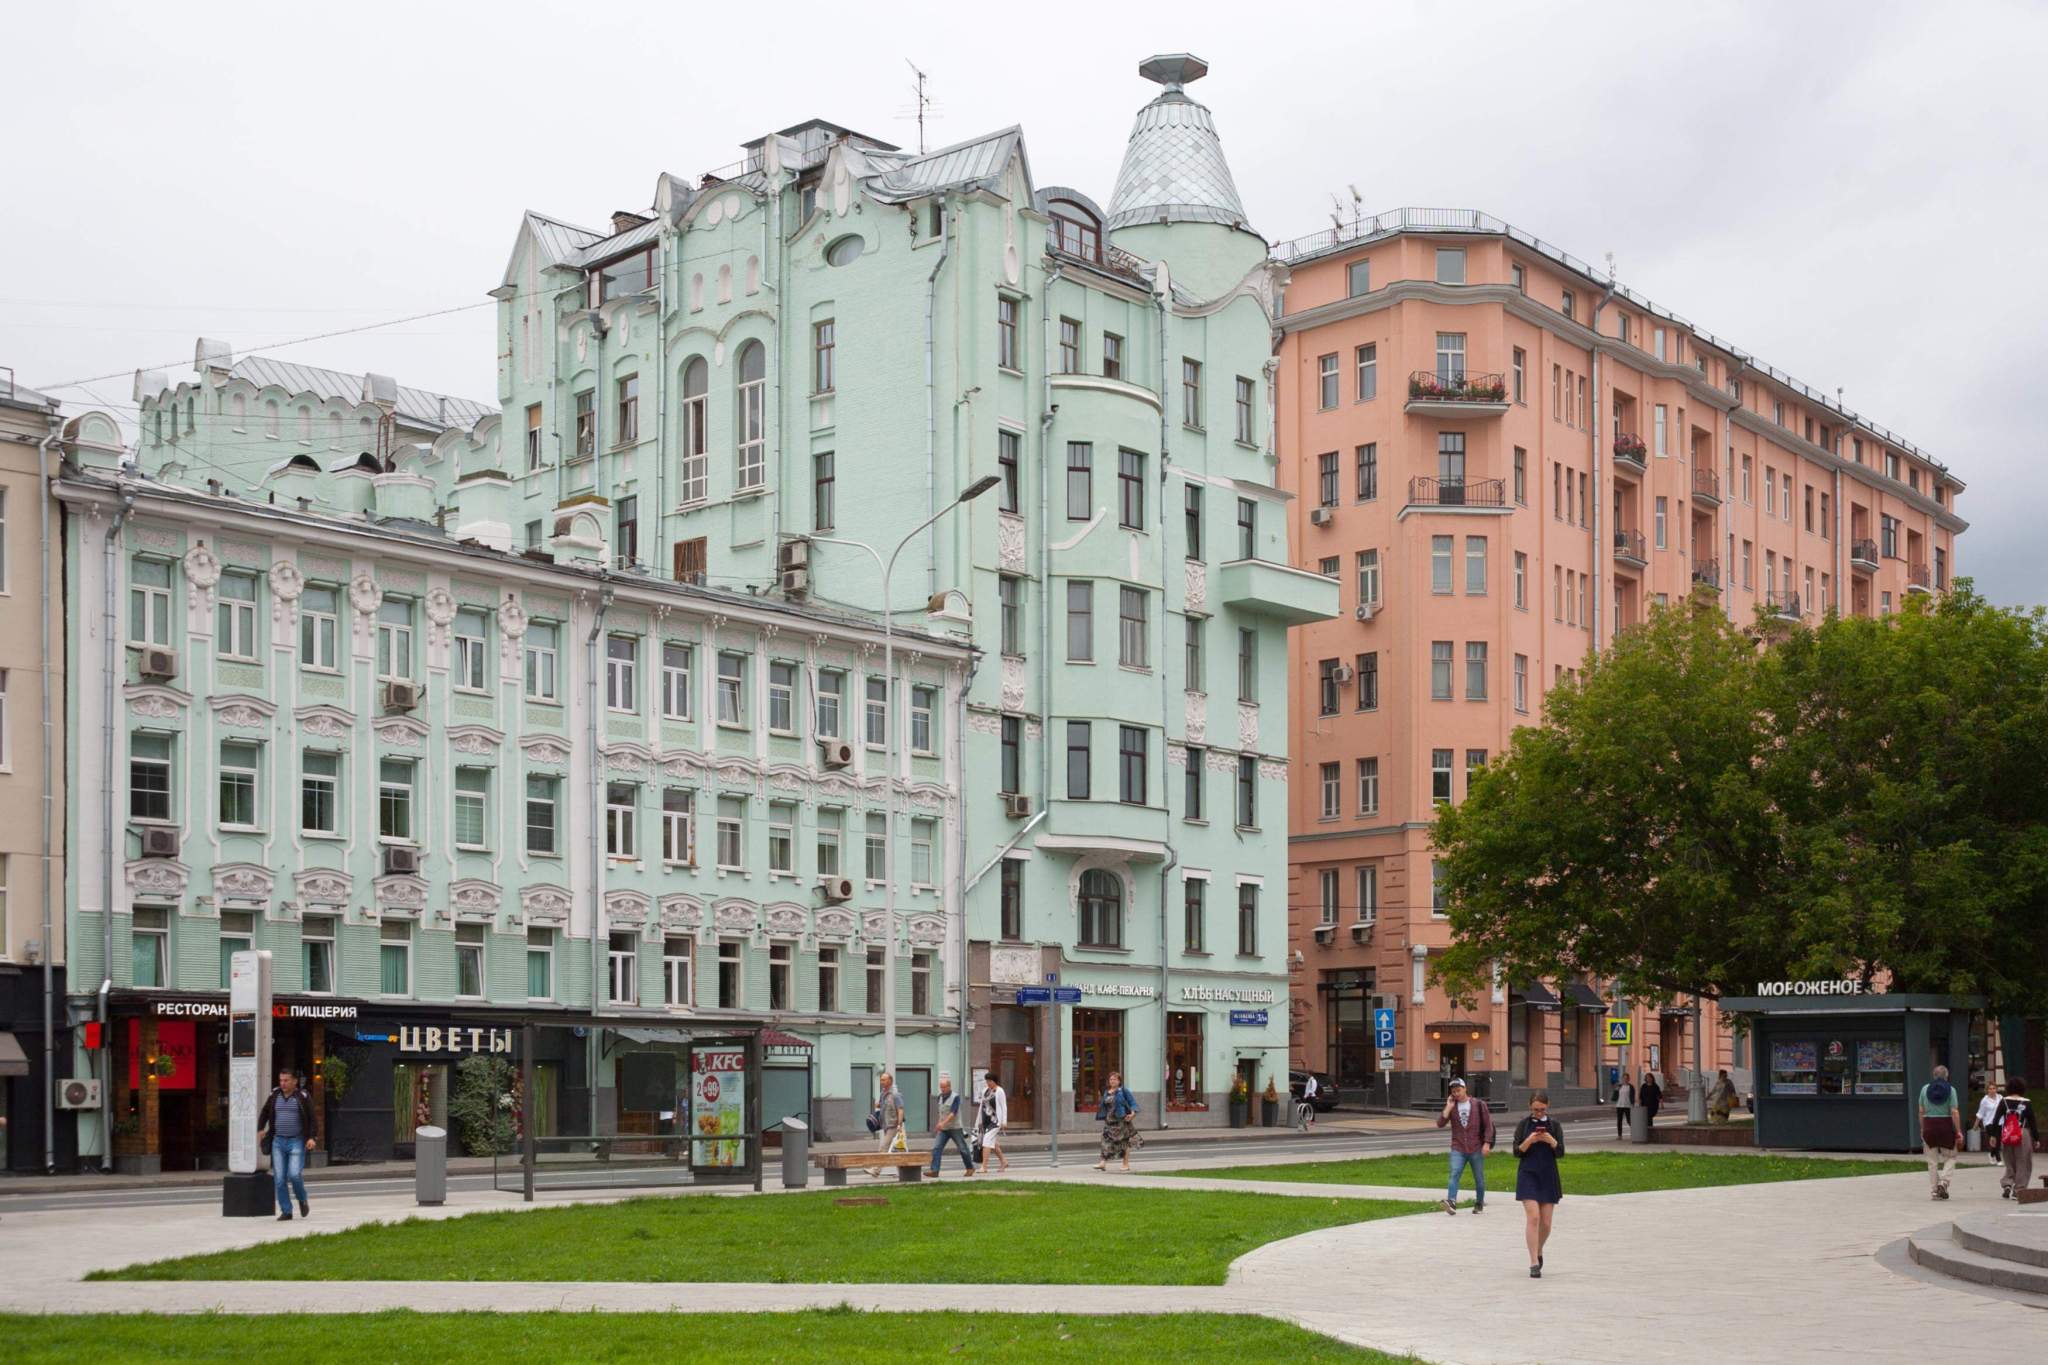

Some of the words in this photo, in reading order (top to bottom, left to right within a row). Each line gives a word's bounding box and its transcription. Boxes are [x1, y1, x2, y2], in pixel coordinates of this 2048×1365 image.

[1214, 987, 1274, 1003] НАСУЩНЫЙ
[1757, 980, 1863, 996] МОРОЖЕНОЕ
[157, 1003, 227, 1016] РЕСТОРАН
[290, 1005, 357, 1018] ПИЦЦЕРИЯ
[400, 1026, 512, 1053] ЦВЕТЫ
[1380, 1031, 1392, 1047] P
[711, 1055, 744, 1070] KFC
